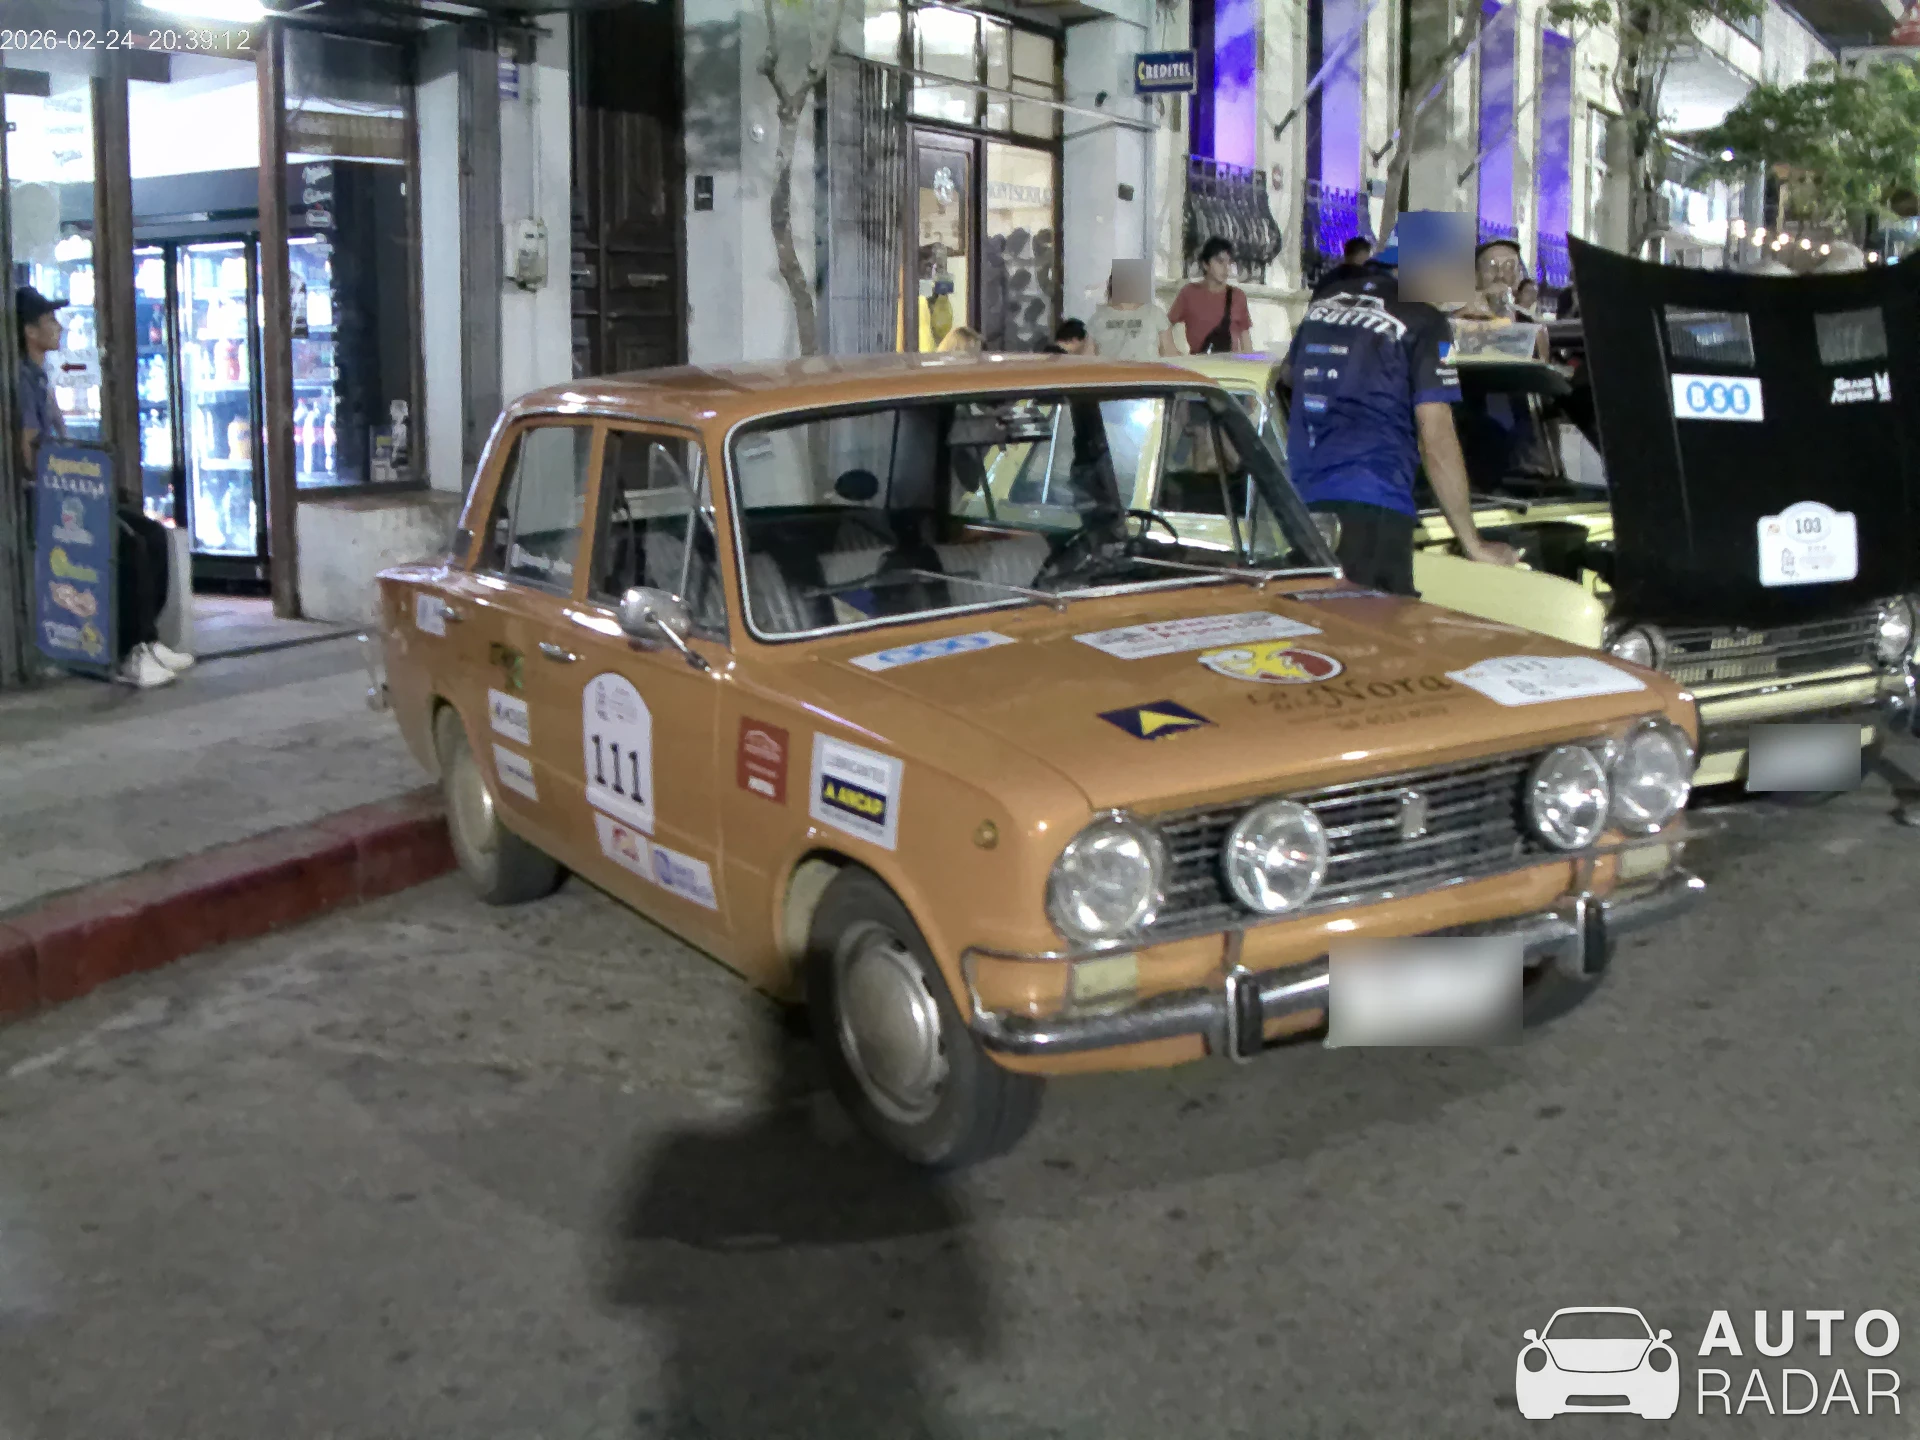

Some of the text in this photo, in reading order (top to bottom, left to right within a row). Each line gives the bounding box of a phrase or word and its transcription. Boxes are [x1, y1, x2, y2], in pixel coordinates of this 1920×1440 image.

[1138, 61, 1190, 80] CREDITEL
[1795, 517, 1822, 535] 103
[1320, 675, 1453, 709] Nora
[591, 733, 644, 806] 111
